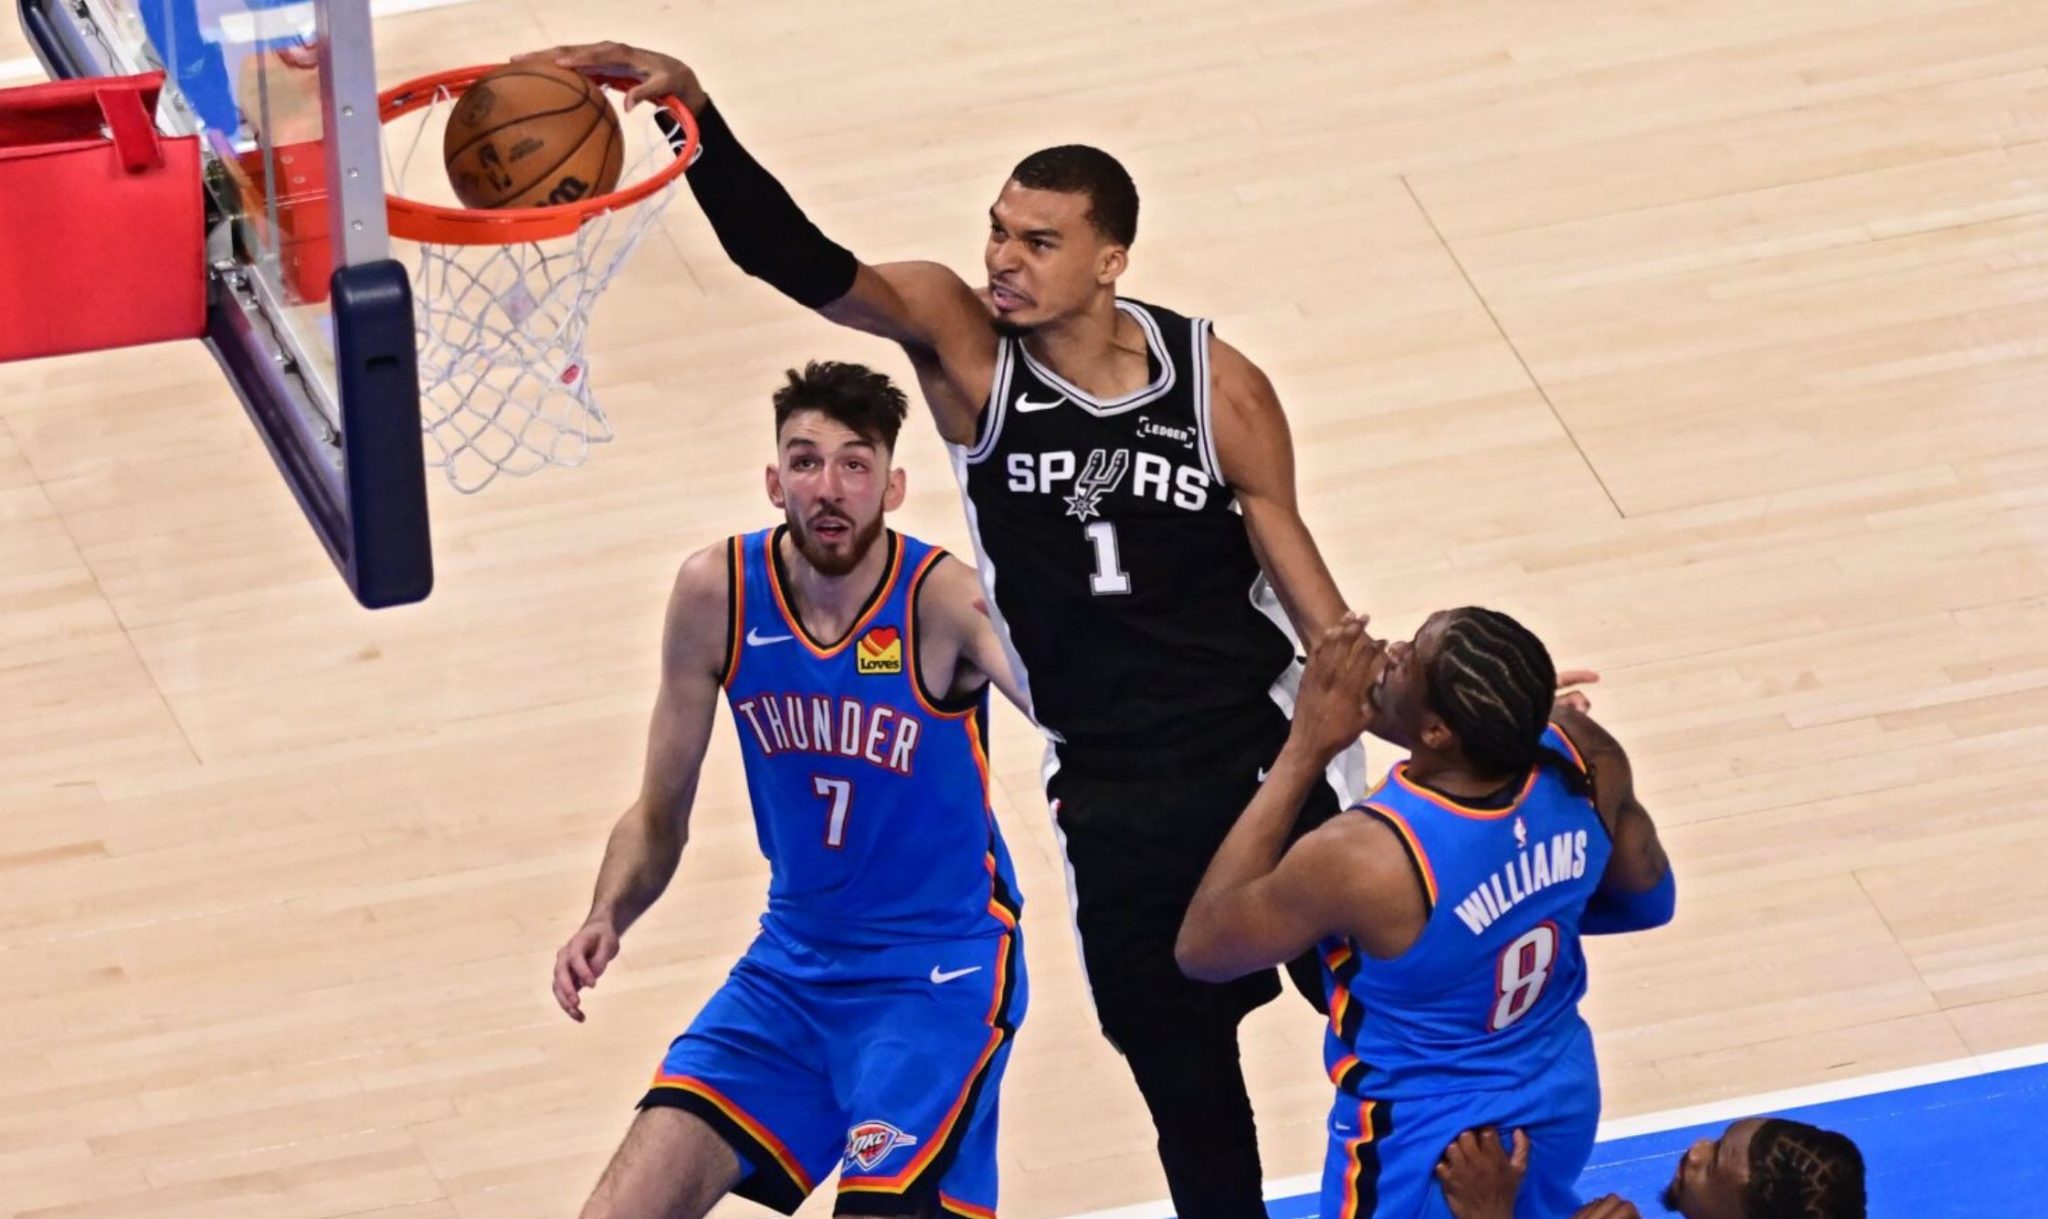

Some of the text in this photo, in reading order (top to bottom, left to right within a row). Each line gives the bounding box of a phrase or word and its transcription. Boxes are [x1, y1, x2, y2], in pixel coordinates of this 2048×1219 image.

[1144, 423, 1188, 441] LEDGER
[1007, 449, 1210, 522] SPURS
[1085, 521, 1131, 595] 1
[737, 694, 920, 775] THUNDER
[812, 775, 852, 847] 7
[1454, 829, 1588, 936] WILLIAMS
[1489, 920, 1558, 1033] 8
